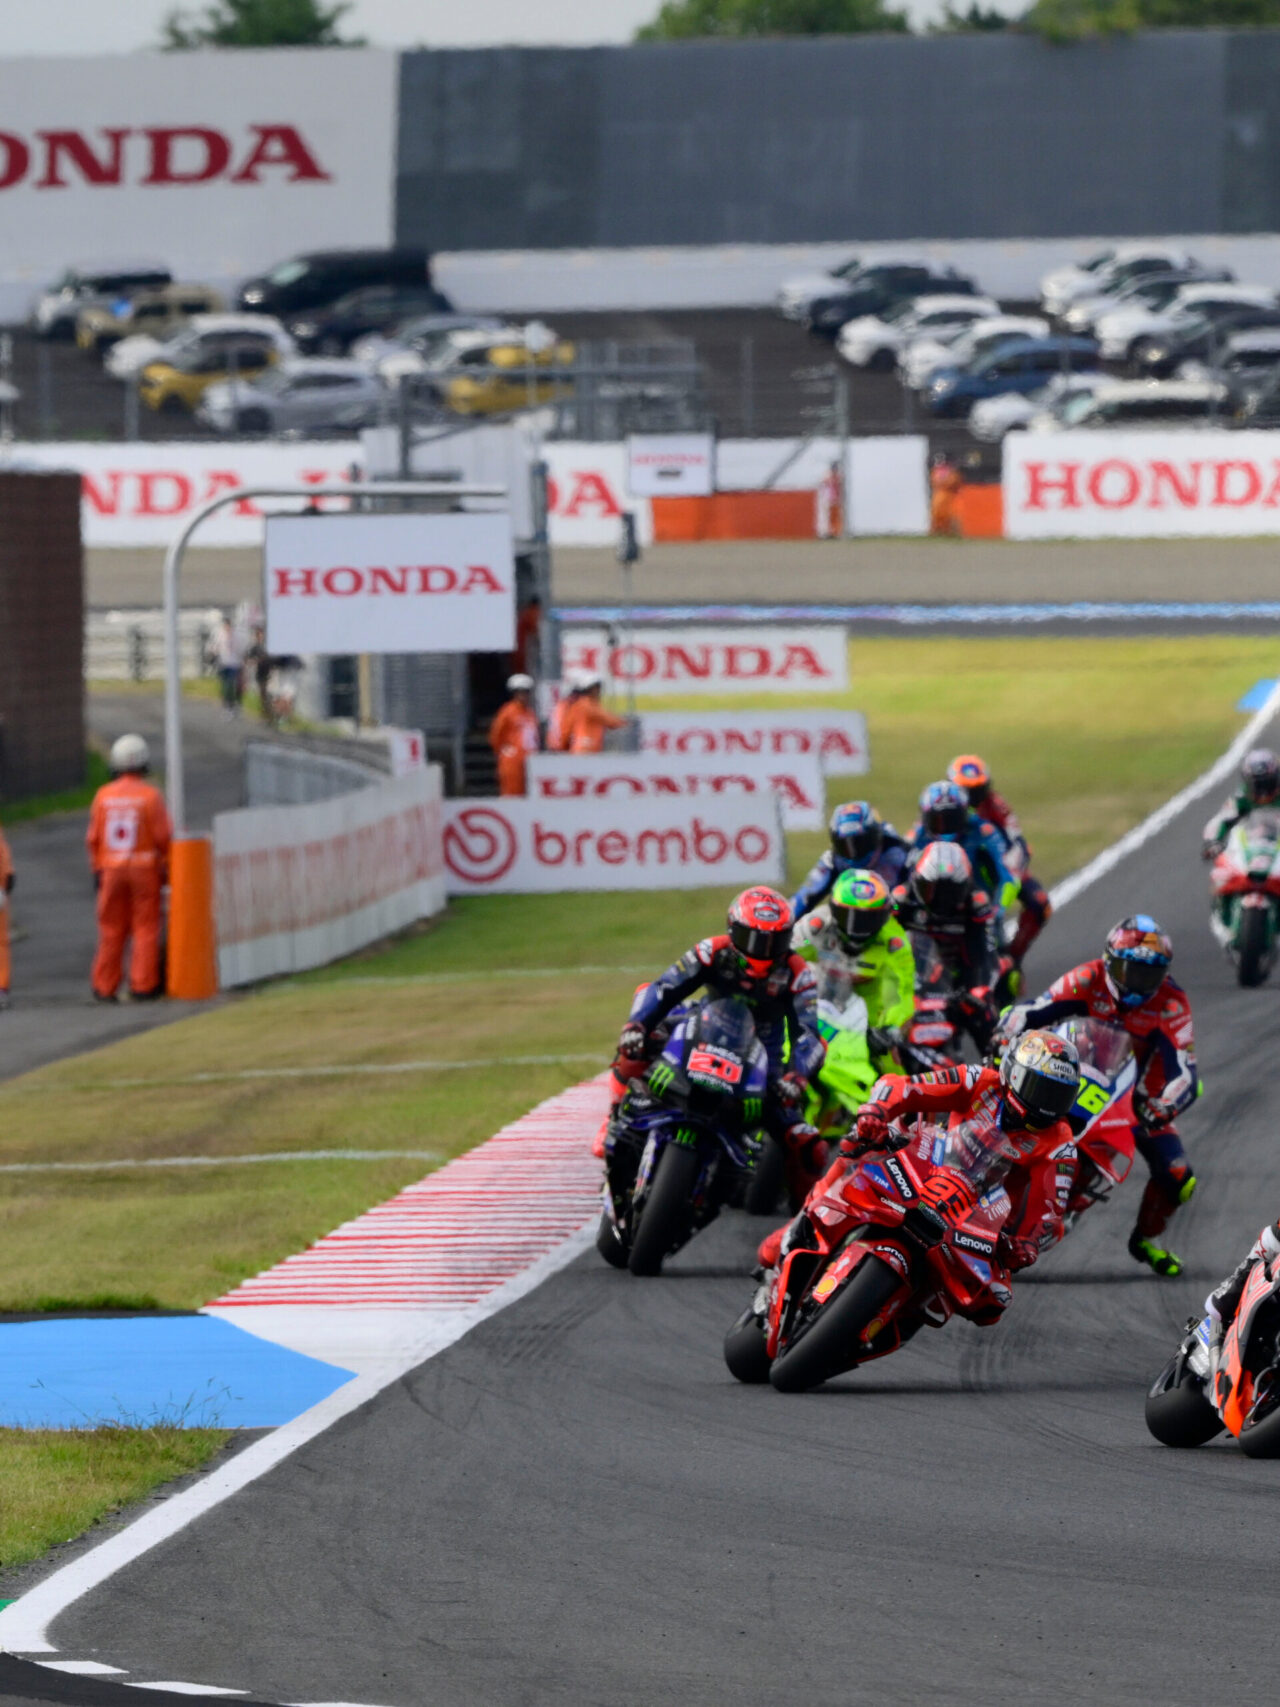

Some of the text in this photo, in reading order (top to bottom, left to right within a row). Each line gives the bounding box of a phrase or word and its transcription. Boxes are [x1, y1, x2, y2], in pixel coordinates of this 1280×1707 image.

[0, 124, 332, 190] NDA
[81, 470, 263, 518] NDA
[273, 565, 506, 597] HONDA
[533, 818, 770, 866] brembo
[873, 1175, 890, 1189] TIM
[886, 1157, 912, 1198] Lenovo
[921, 1175, 974, 1227] 93
[955, 1232, 993, 1254] Lenovo
